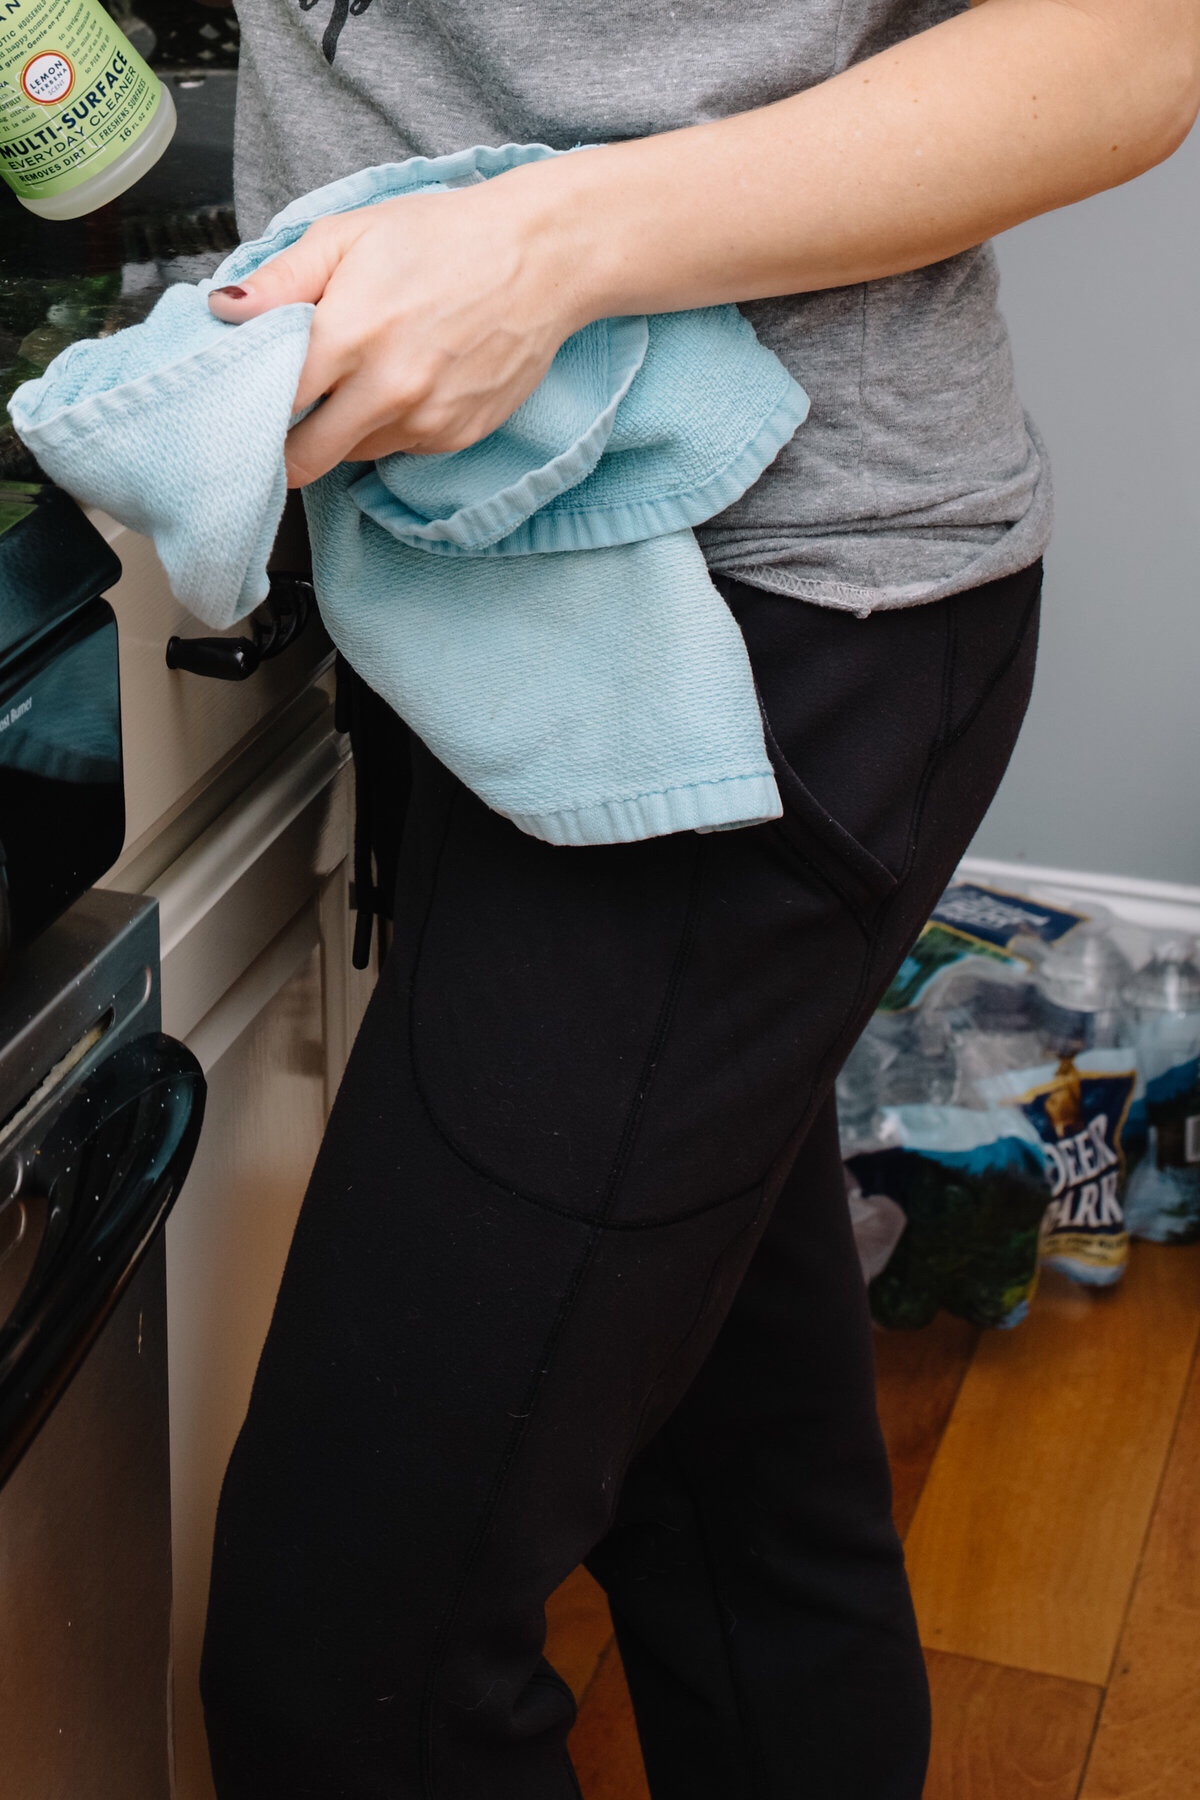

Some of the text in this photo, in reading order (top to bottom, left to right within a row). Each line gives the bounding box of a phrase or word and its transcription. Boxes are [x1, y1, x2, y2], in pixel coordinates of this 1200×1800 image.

[5, 34, 29, 55] happy
[28, 13, 49, 34] homes
[5, 50, 27, 68] grime.
[27, 29, 48, 49] Gentle
[47, 21, 56, 30] on
[55, 6, 66, 22] your
[29, 60, 63, 90] LEMON
[35, 68, 68, 95] VERBENA
[47, 79, 65, 96] SCENT
[8, 65, 137, 170] EVERYDAY CLEANER
[18, 79, 147, 183] REMOVES DIRT FRESHENS SURFACES
[21, 113, 37, 124] said
[118, 127, 132, 143] 16
[10, 696, 33, 724] Burner
[1044, 1169, 1124, 1229] ARK
